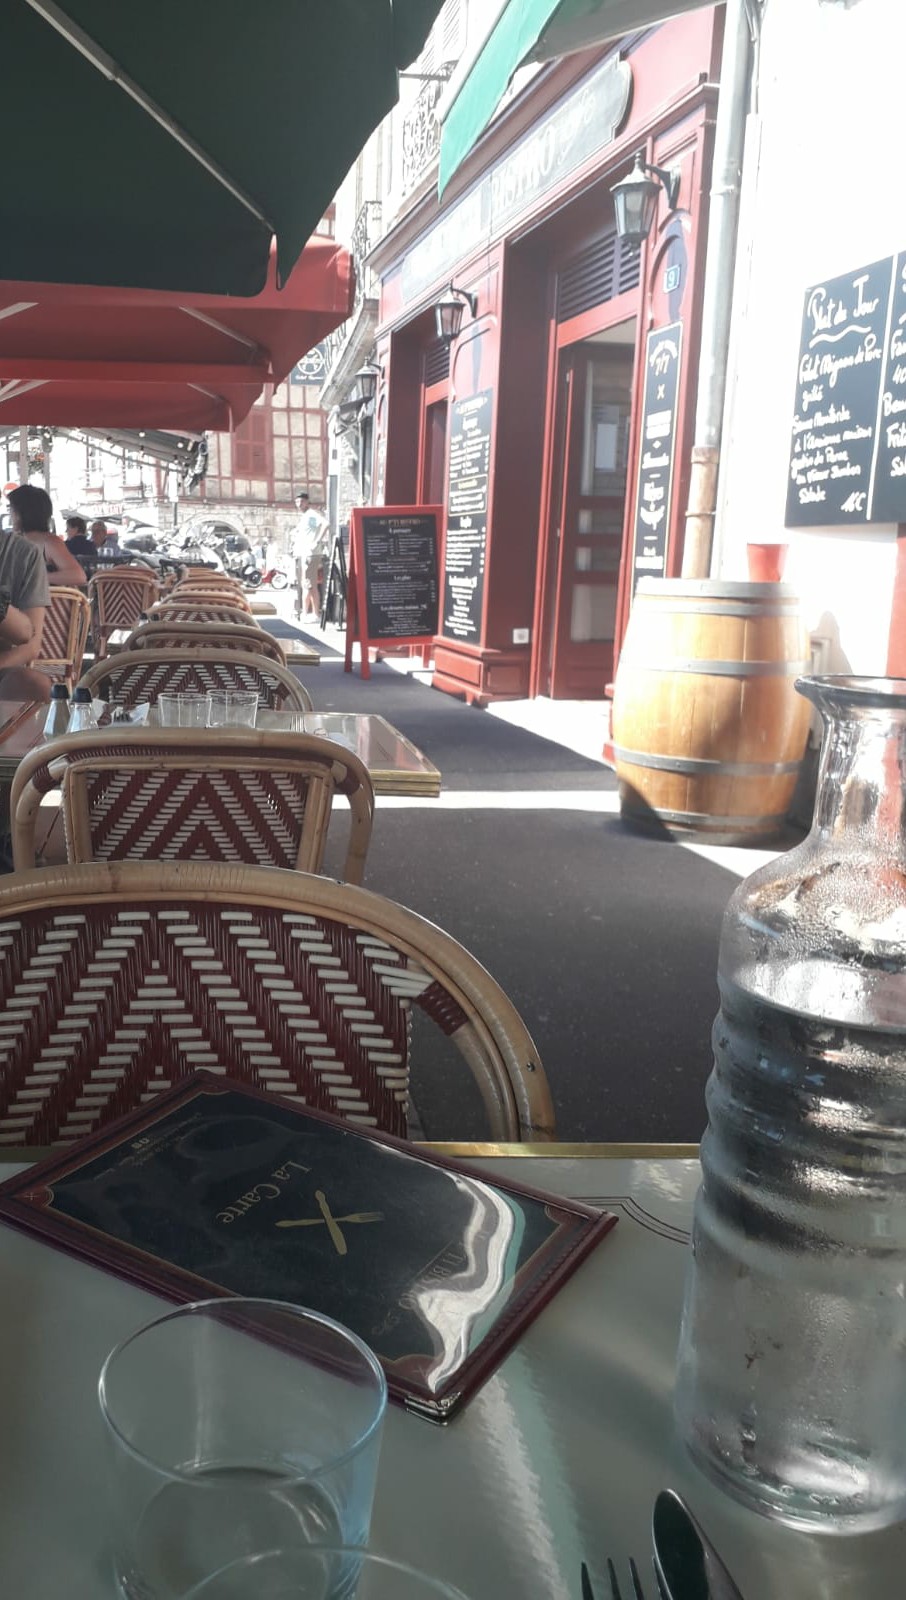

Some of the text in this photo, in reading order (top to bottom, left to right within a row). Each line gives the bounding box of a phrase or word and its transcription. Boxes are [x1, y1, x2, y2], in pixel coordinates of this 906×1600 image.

[668, 270, 675, 289] 9
[853, 274, 879, 318] Jour
[216, 1160, 312, 1224] La Carte
